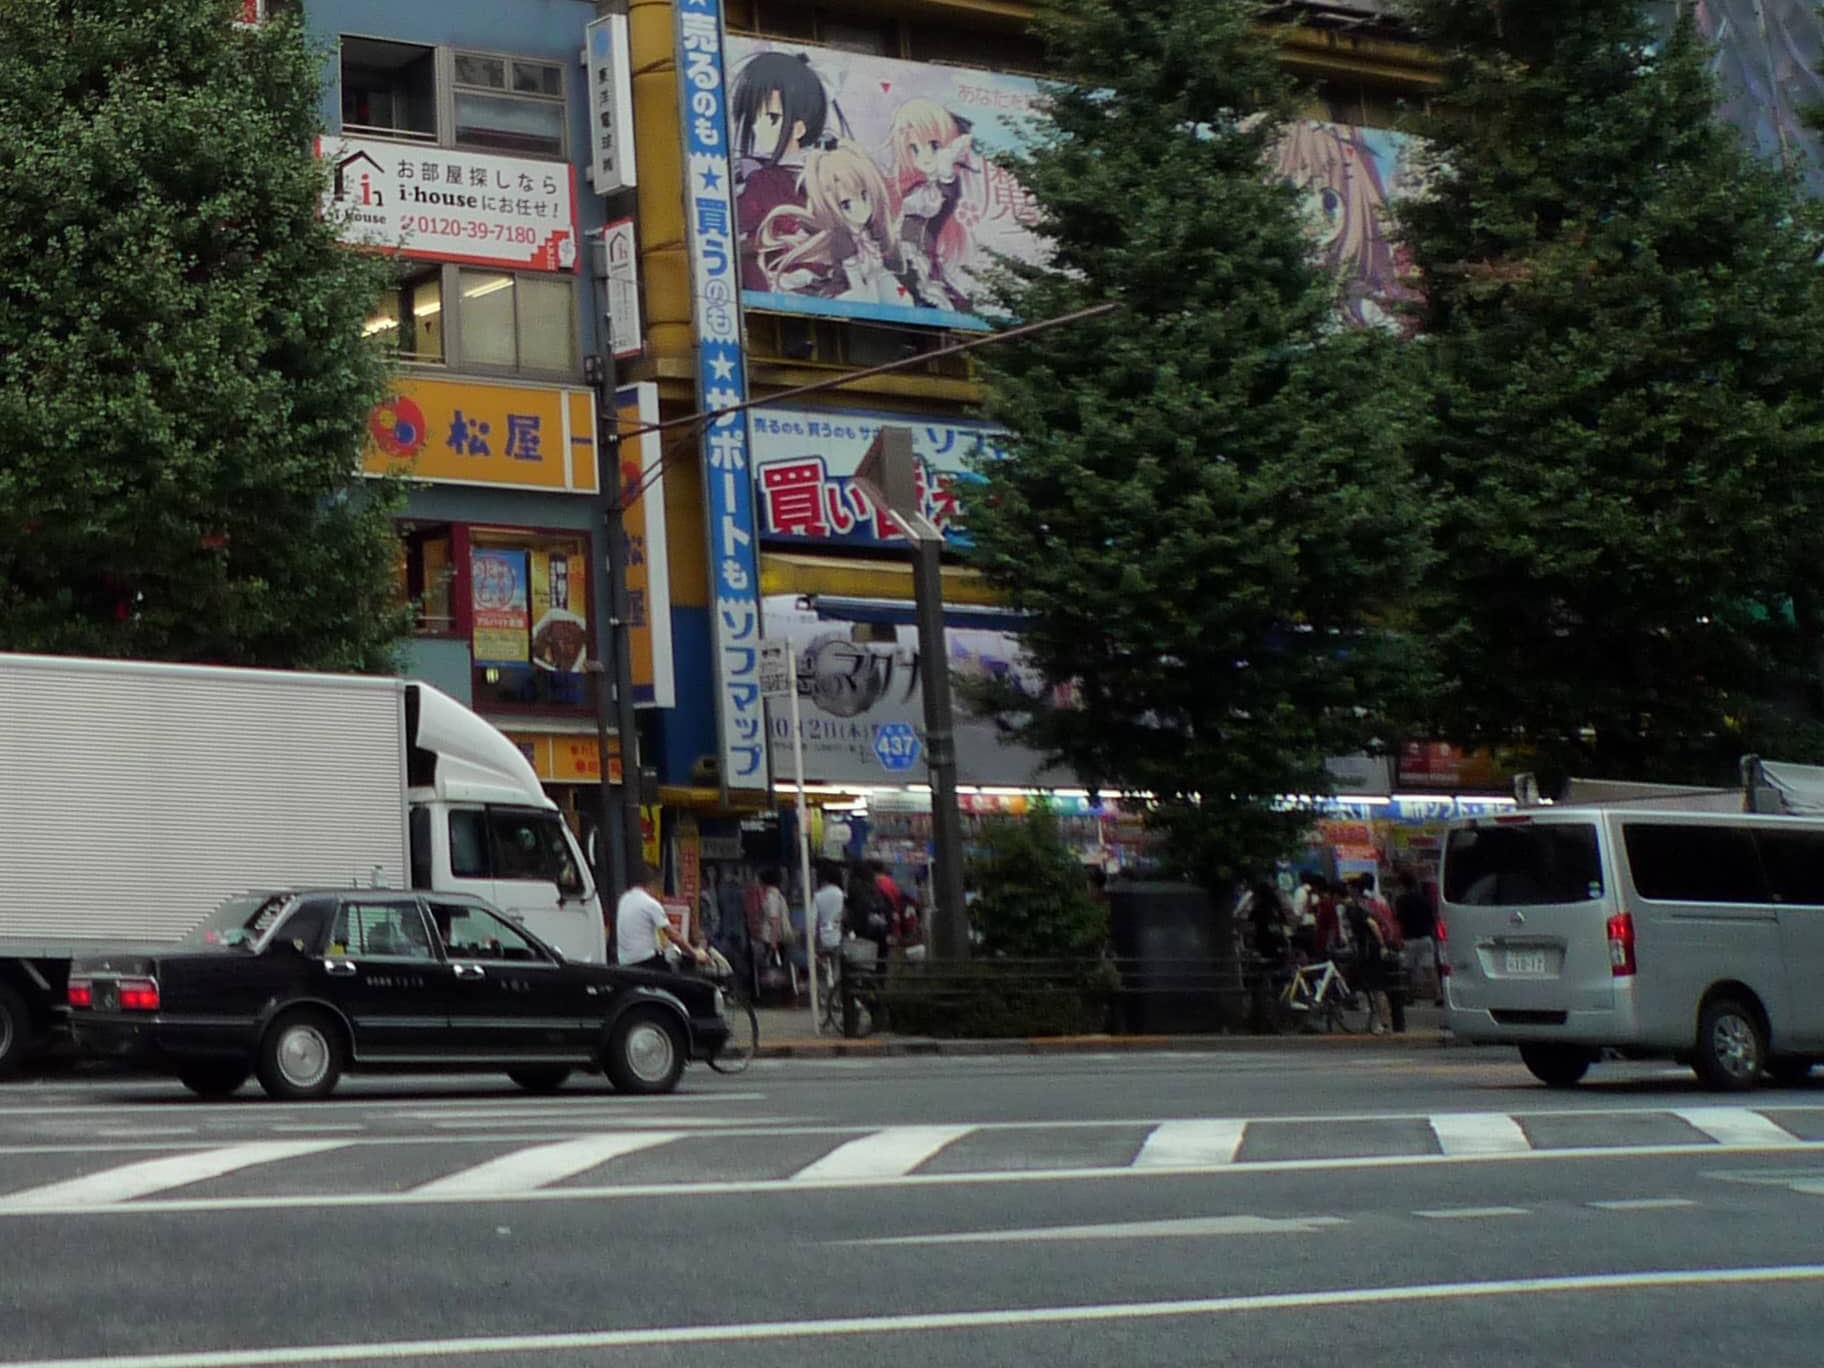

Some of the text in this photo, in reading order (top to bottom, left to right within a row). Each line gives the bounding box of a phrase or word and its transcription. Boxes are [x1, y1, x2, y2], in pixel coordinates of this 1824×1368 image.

[398, 159, 558, 194] お部屋探しなら
[418, 216, 537, 245] 0120-39-7180
[682, 12, 763, 777] 売るのも 買うのも サポートも ソフマップ
[447, 409, 544, 462] 松屋
[879, 735, 913, 758] 437
